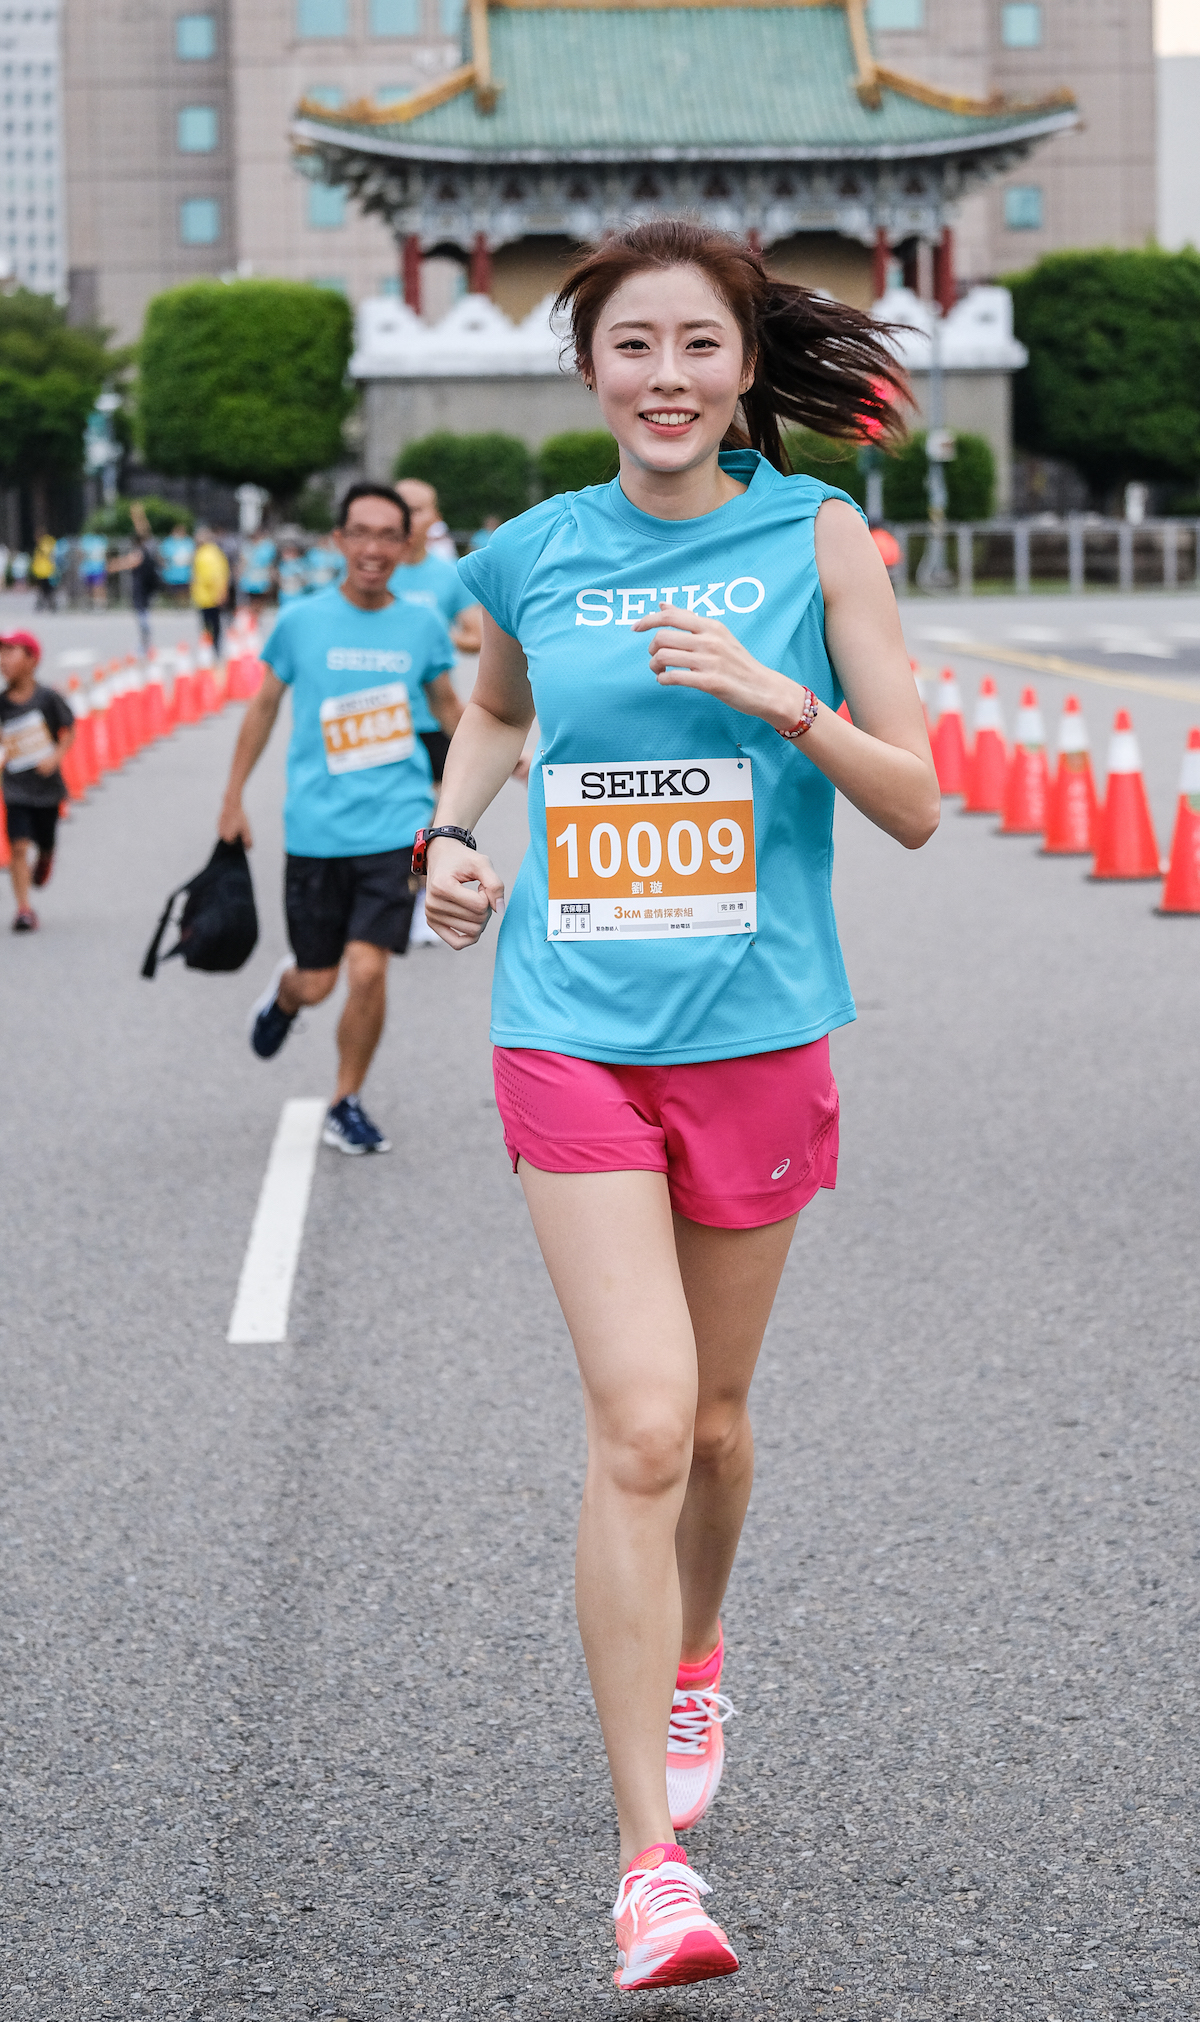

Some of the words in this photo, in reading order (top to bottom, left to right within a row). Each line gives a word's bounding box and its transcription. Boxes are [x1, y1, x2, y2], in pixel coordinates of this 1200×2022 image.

[575, 576, 766, 627] SEIKO
[326, 646, 413, 674] SEIKO
[580, 768, 711, 800] SEIKO
[556, 818, 745, 879] 10009
[614, 906, 642, 919] 3KM
[644, 907, 694, 918] 盡情探索組
